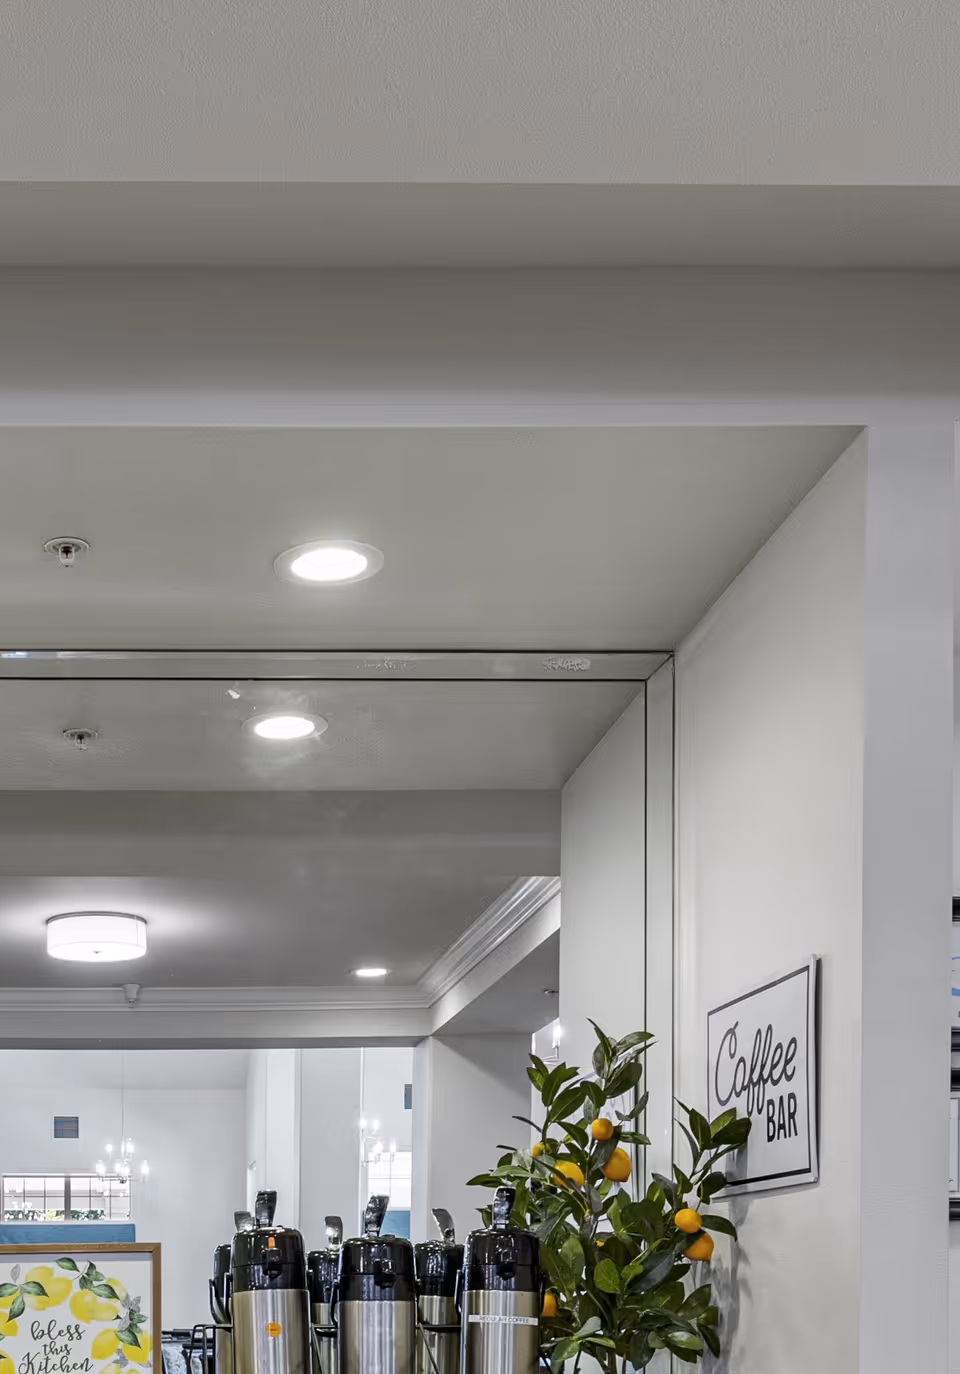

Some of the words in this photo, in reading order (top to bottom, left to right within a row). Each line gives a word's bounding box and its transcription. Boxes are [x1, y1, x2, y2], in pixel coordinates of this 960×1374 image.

[715, 1020, 797, 1118] Coffee
[766, 1092, 798, 1143] BAR
[30, 1319, 86, 1341] bless
[42, 1341, 72, 1356] this
